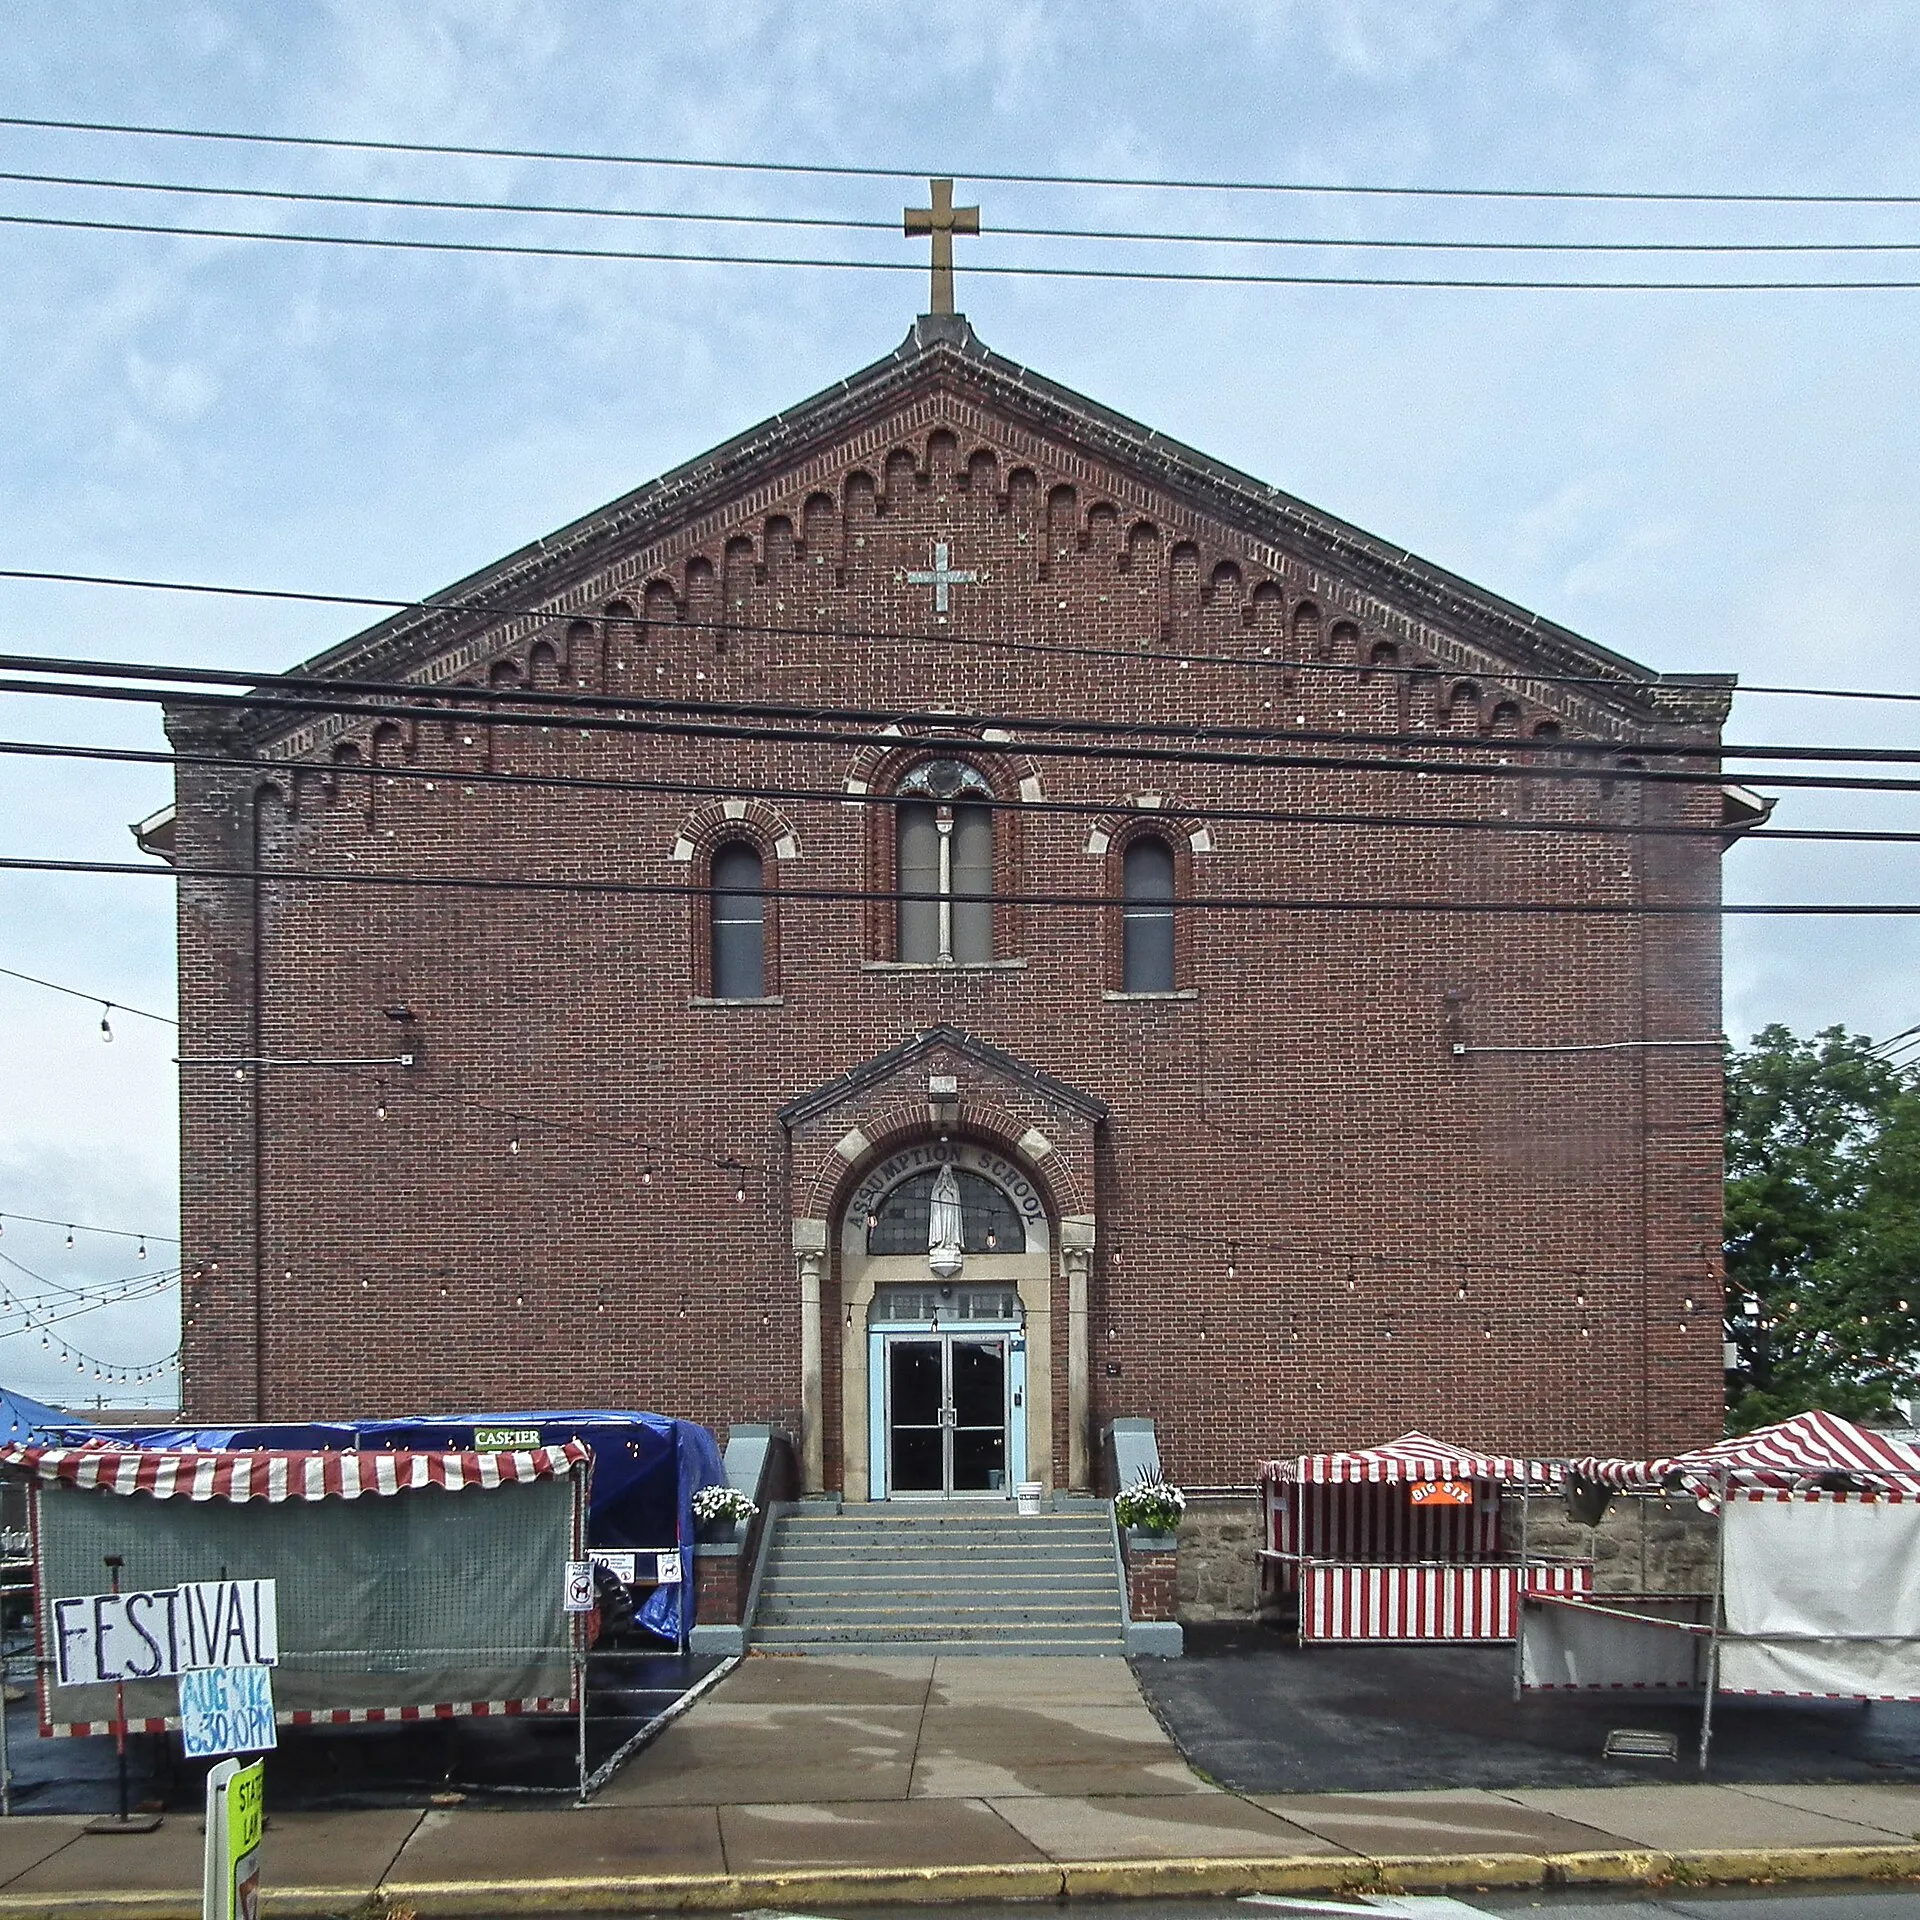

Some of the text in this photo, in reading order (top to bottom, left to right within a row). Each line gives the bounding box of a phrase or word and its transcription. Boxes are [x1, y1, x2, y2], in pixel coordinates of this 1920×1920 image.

[849, 1148, 1046, 1230] ASSUMPTION SCHOOL
[475, 1430, 540, 1446] CASHIER
[1411, 1481, 1469, 1503] BIG SIX
[55, 1580, 276, 1683] FESTIVAL
[182, 1667, 229, 1715] AUG
